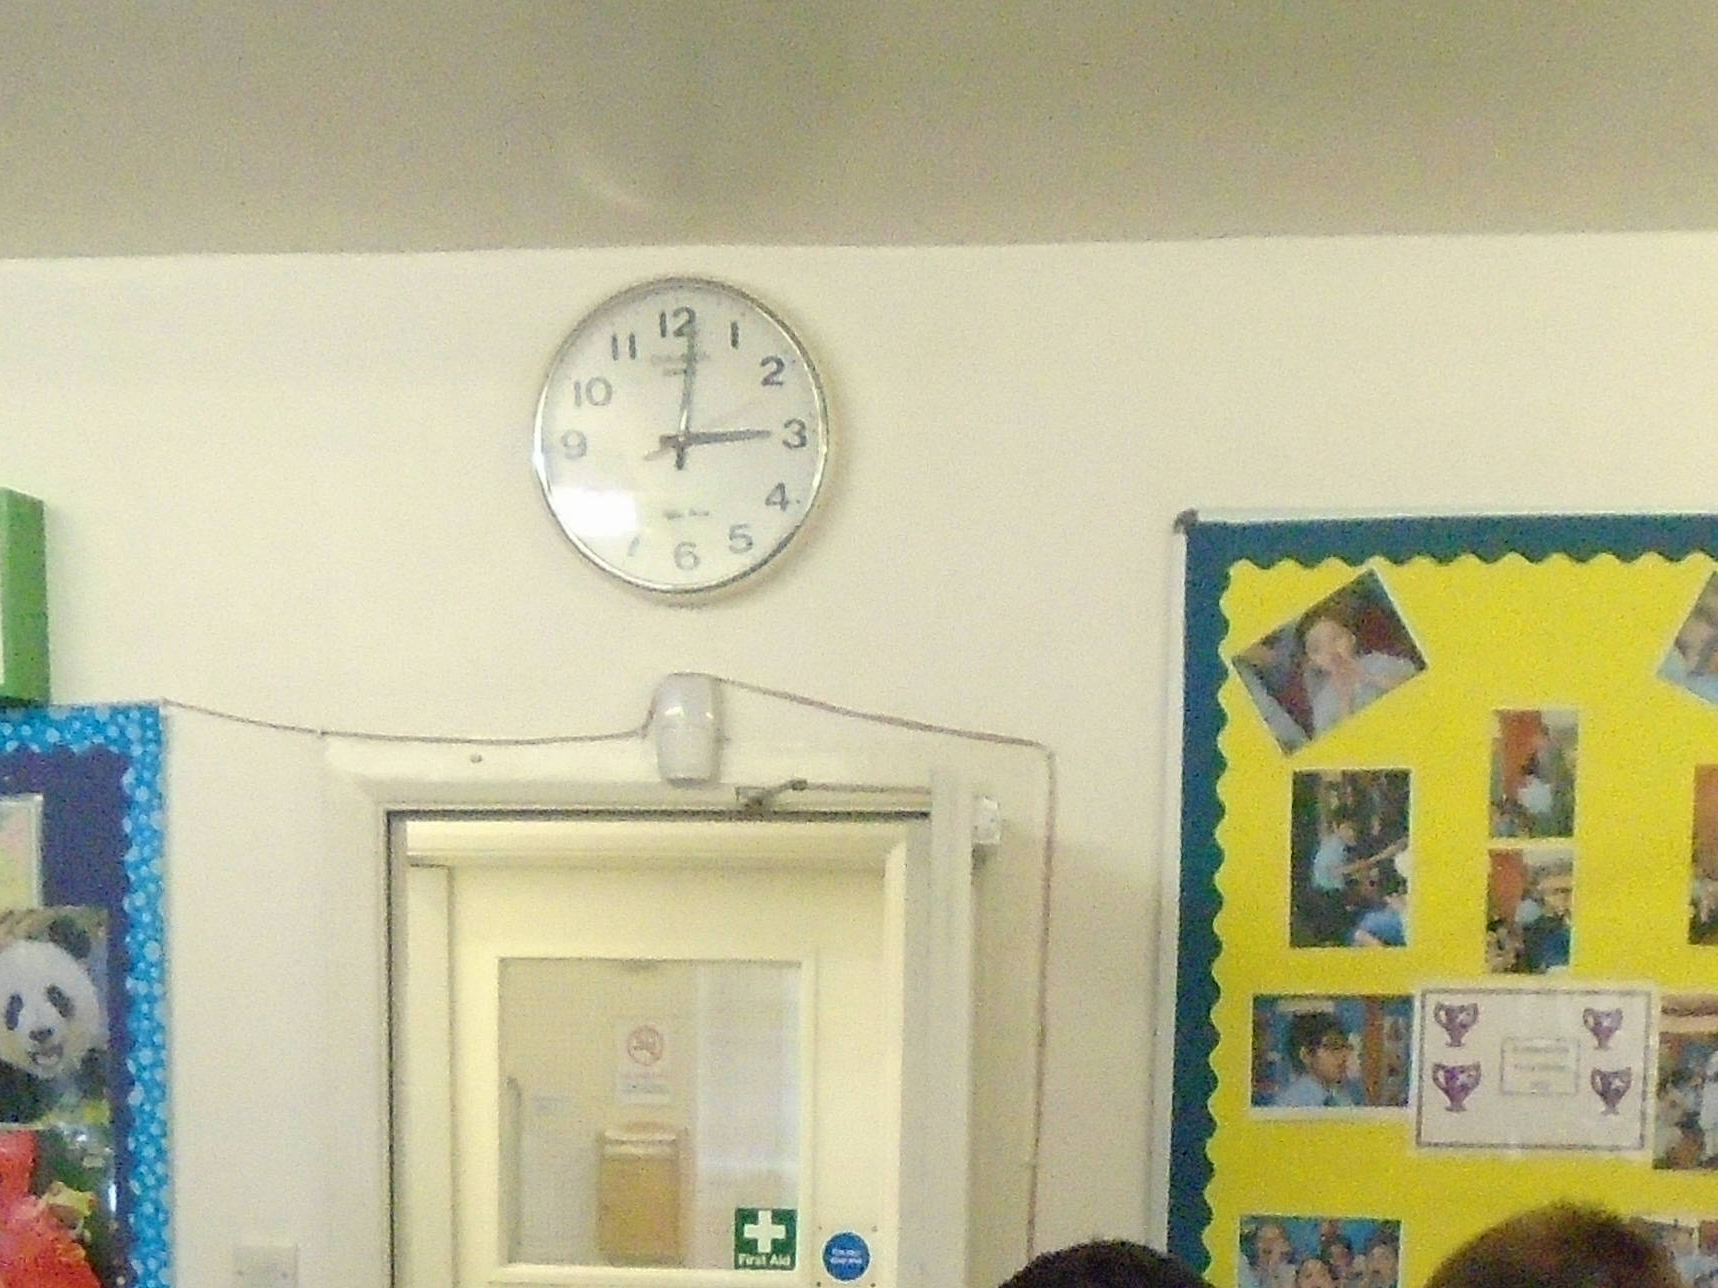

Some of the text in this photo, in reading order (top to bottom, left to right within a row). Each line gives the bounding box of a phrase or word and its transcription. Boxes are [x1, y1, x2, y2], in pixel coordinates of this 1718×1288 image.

[659, 307, 696, 338] 12
[730, 321, 739, 350] 1
[611, 332, 636, 361] 11
[760, 355, 784, 387] 2
[574, 376, 613, 407] 10
[561, 429, 587, 460] 9
[782, 418, 807, 449] 3
[764, 482, 789, 511] 4
[728, 523, 753, 554] 5
[674, 541, 700, 571] 6
[738, 1253, 792, 1266] First Aid
